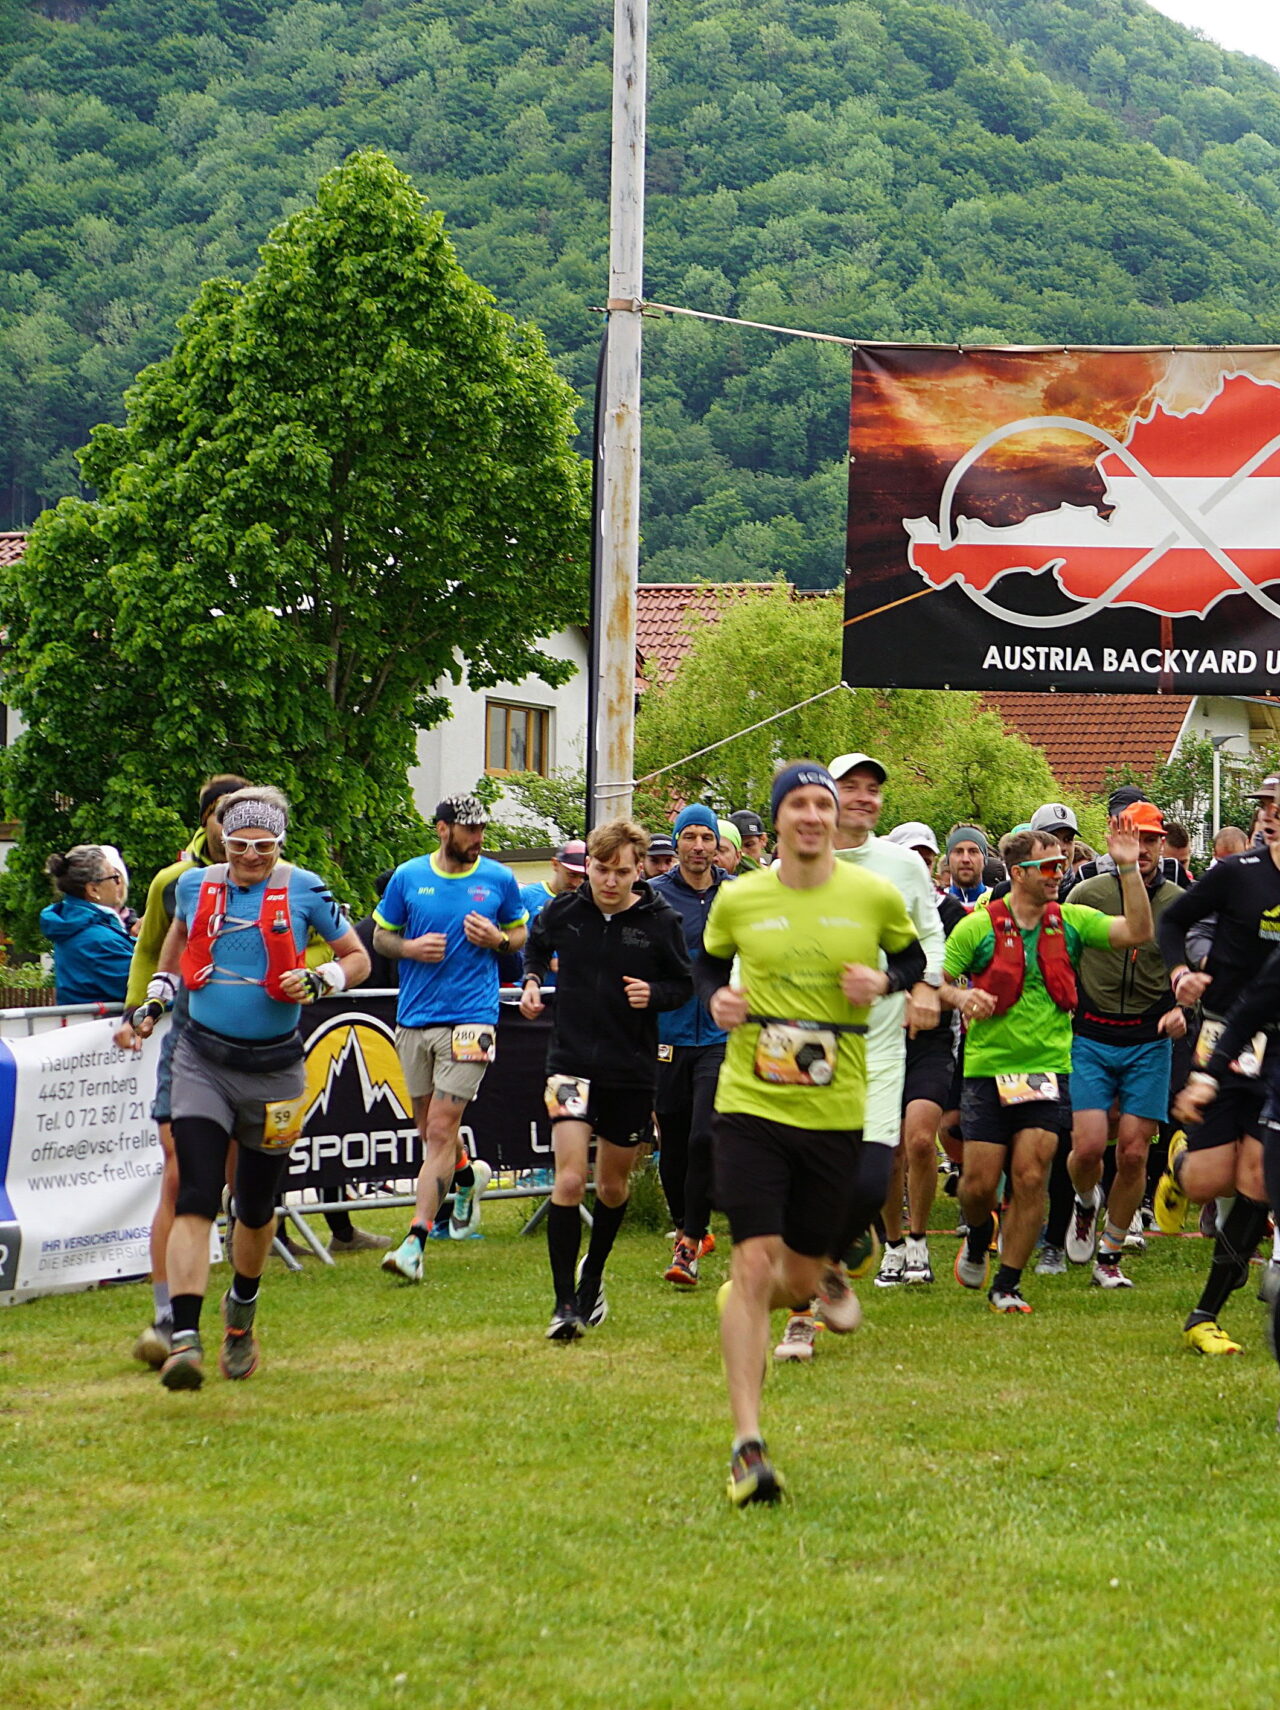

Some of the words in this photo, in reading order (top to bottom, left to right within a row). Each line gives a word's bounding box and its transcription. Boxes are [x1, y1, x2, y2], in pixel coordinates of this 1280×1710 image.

[982, 645, 1094, 671] AUSTRIA
[1103, 648, 1257, 674] BACKYARD
[454, 1031, 475, 1042] 280
[38, 1081, 74, 1102] 4452
[79, 1076, 137, 1098] Ternberg
[37, 1112, 61, 1132] Tel.
[65, 1110, 75, 1128] 0
[80, 1108, 97, 1127] 72
[101, 1104, 117, 1125] 56
[129, 1101, 146, 1121] 21
[273, 1110, 290, 1124] 59
[31, 1129, 158, 1162] office@vsc-frelle
[28, 1160, 164, 1191] www.vsc-freller.a
[63, 1226, 152, 1249] VERSICHERUNGS
[39, 1256, 60, 1272] DIE
[62, 1251, 96, 1268] BESTE
[100, 1244, 149, 1262] VERSIC
